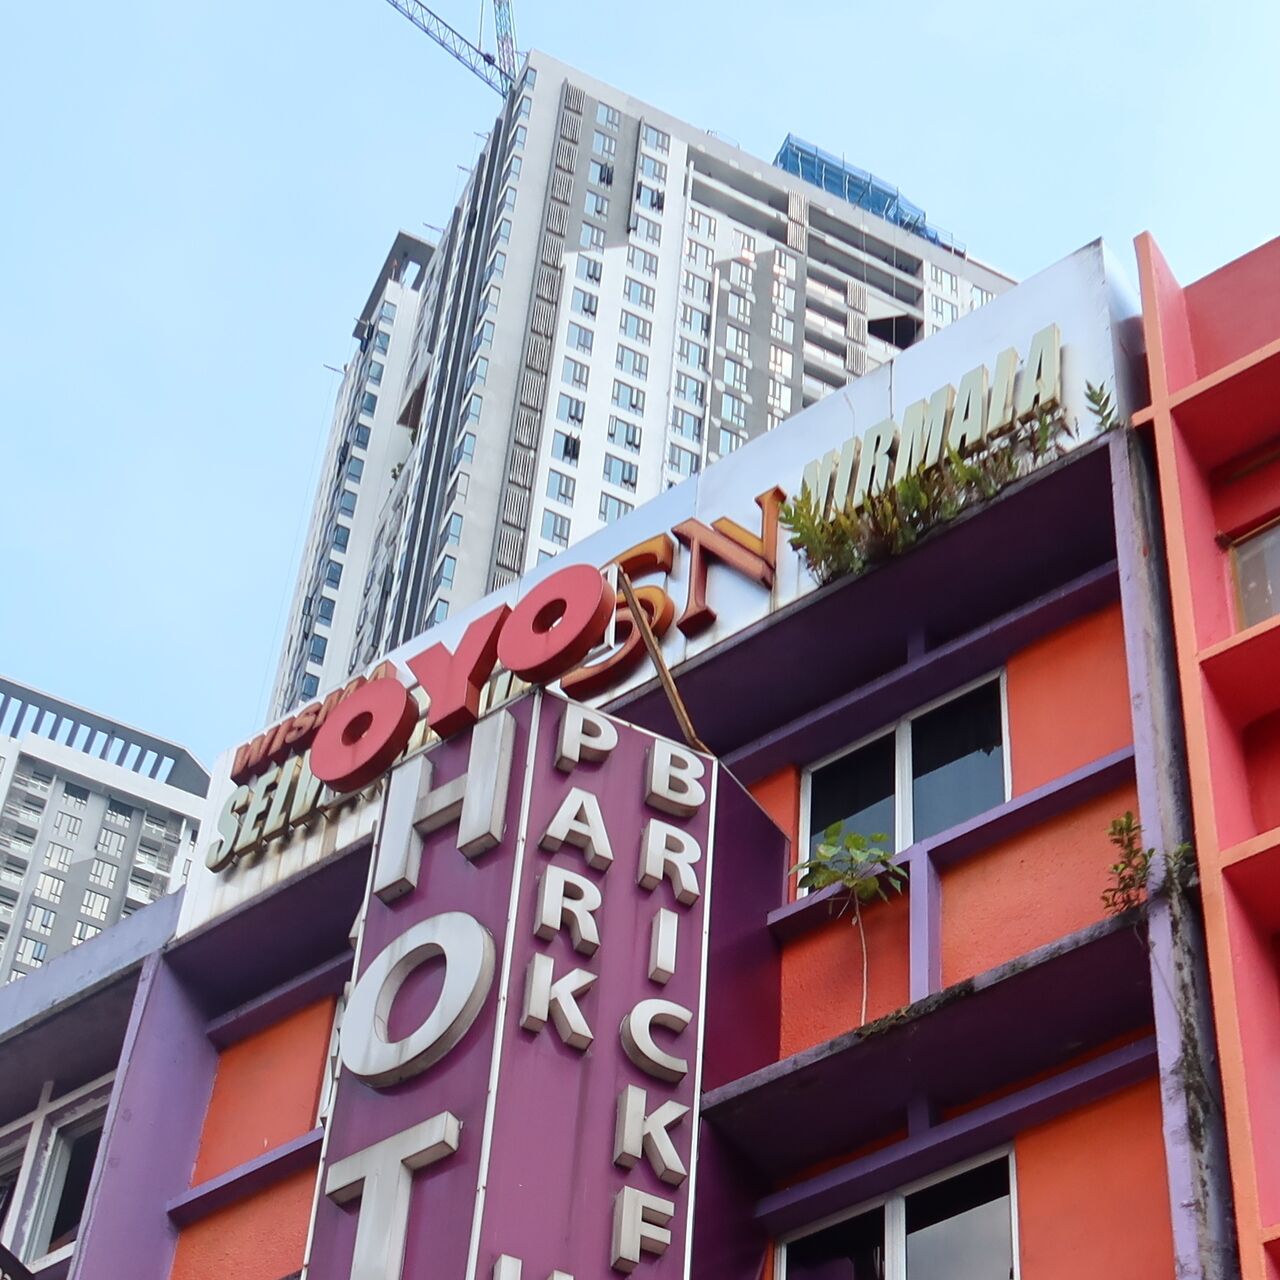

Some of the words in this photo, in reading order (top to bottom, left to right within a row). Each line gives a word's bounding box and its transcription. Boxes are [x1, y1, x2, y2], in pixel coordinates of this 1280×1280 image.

[800, 322, 1062, 525] NIRMALA
[309, 562, 616, 793] OYO
[522, 702, 619, 1053] PARK
